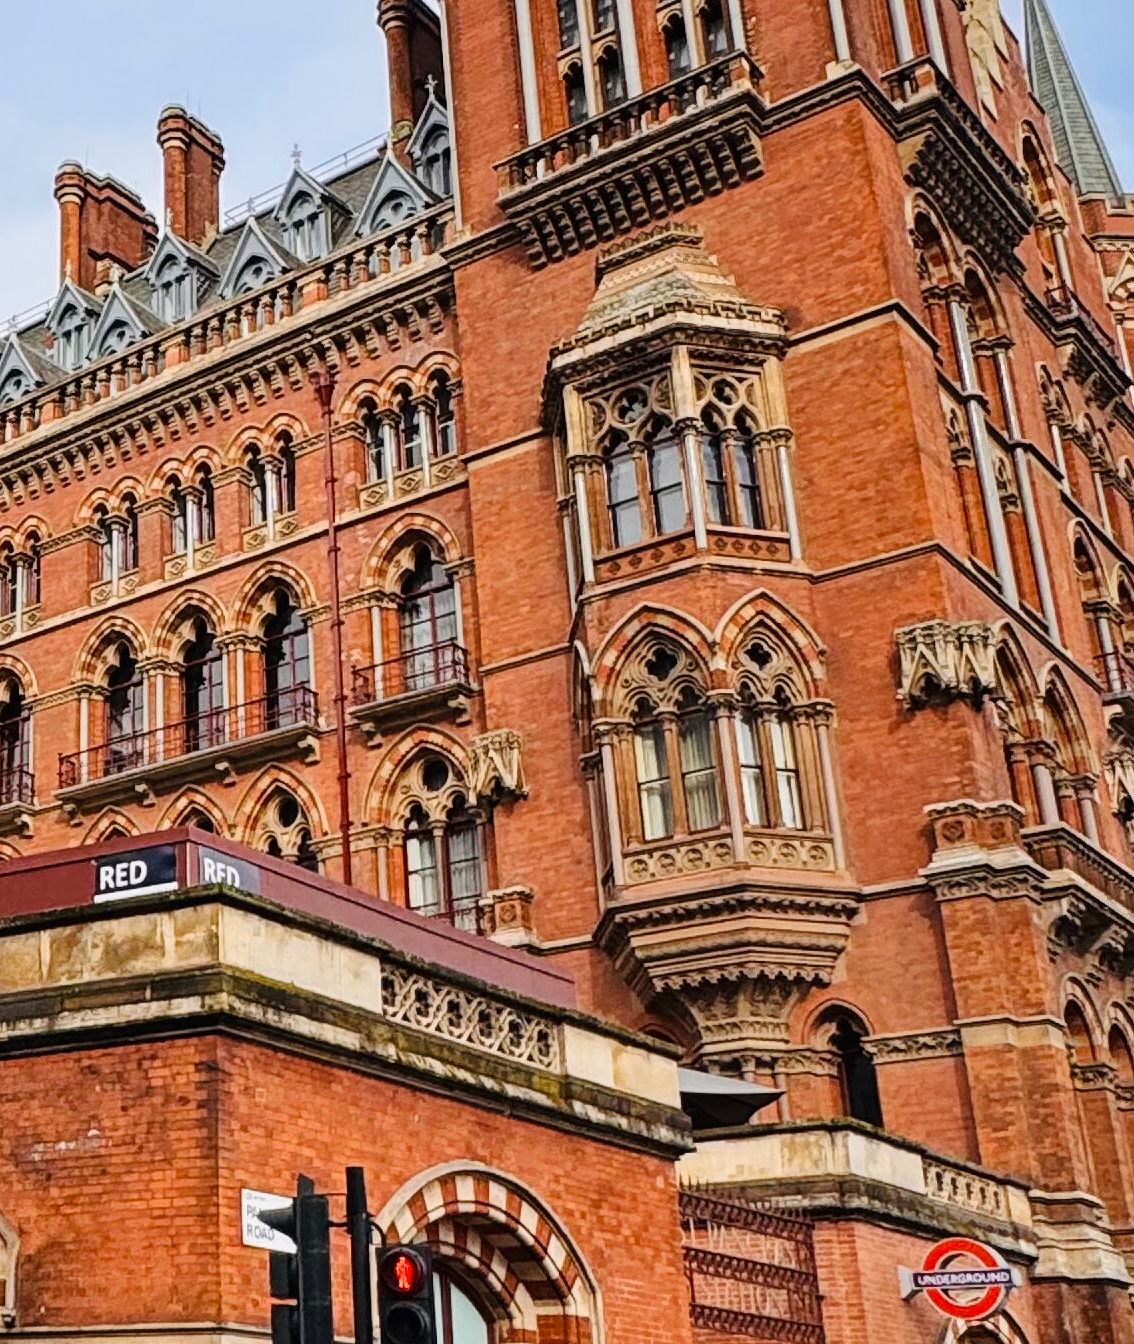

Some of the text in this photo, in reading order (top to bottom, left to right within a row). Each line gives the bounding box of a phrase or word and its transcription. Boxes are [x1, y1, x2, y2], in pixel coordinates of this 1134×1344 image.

[99, 859, 148, 891] RED
[246, 1223, 275, 1242] ROAD
[917, 1271, 1010, 1286] UNDERGROUND
